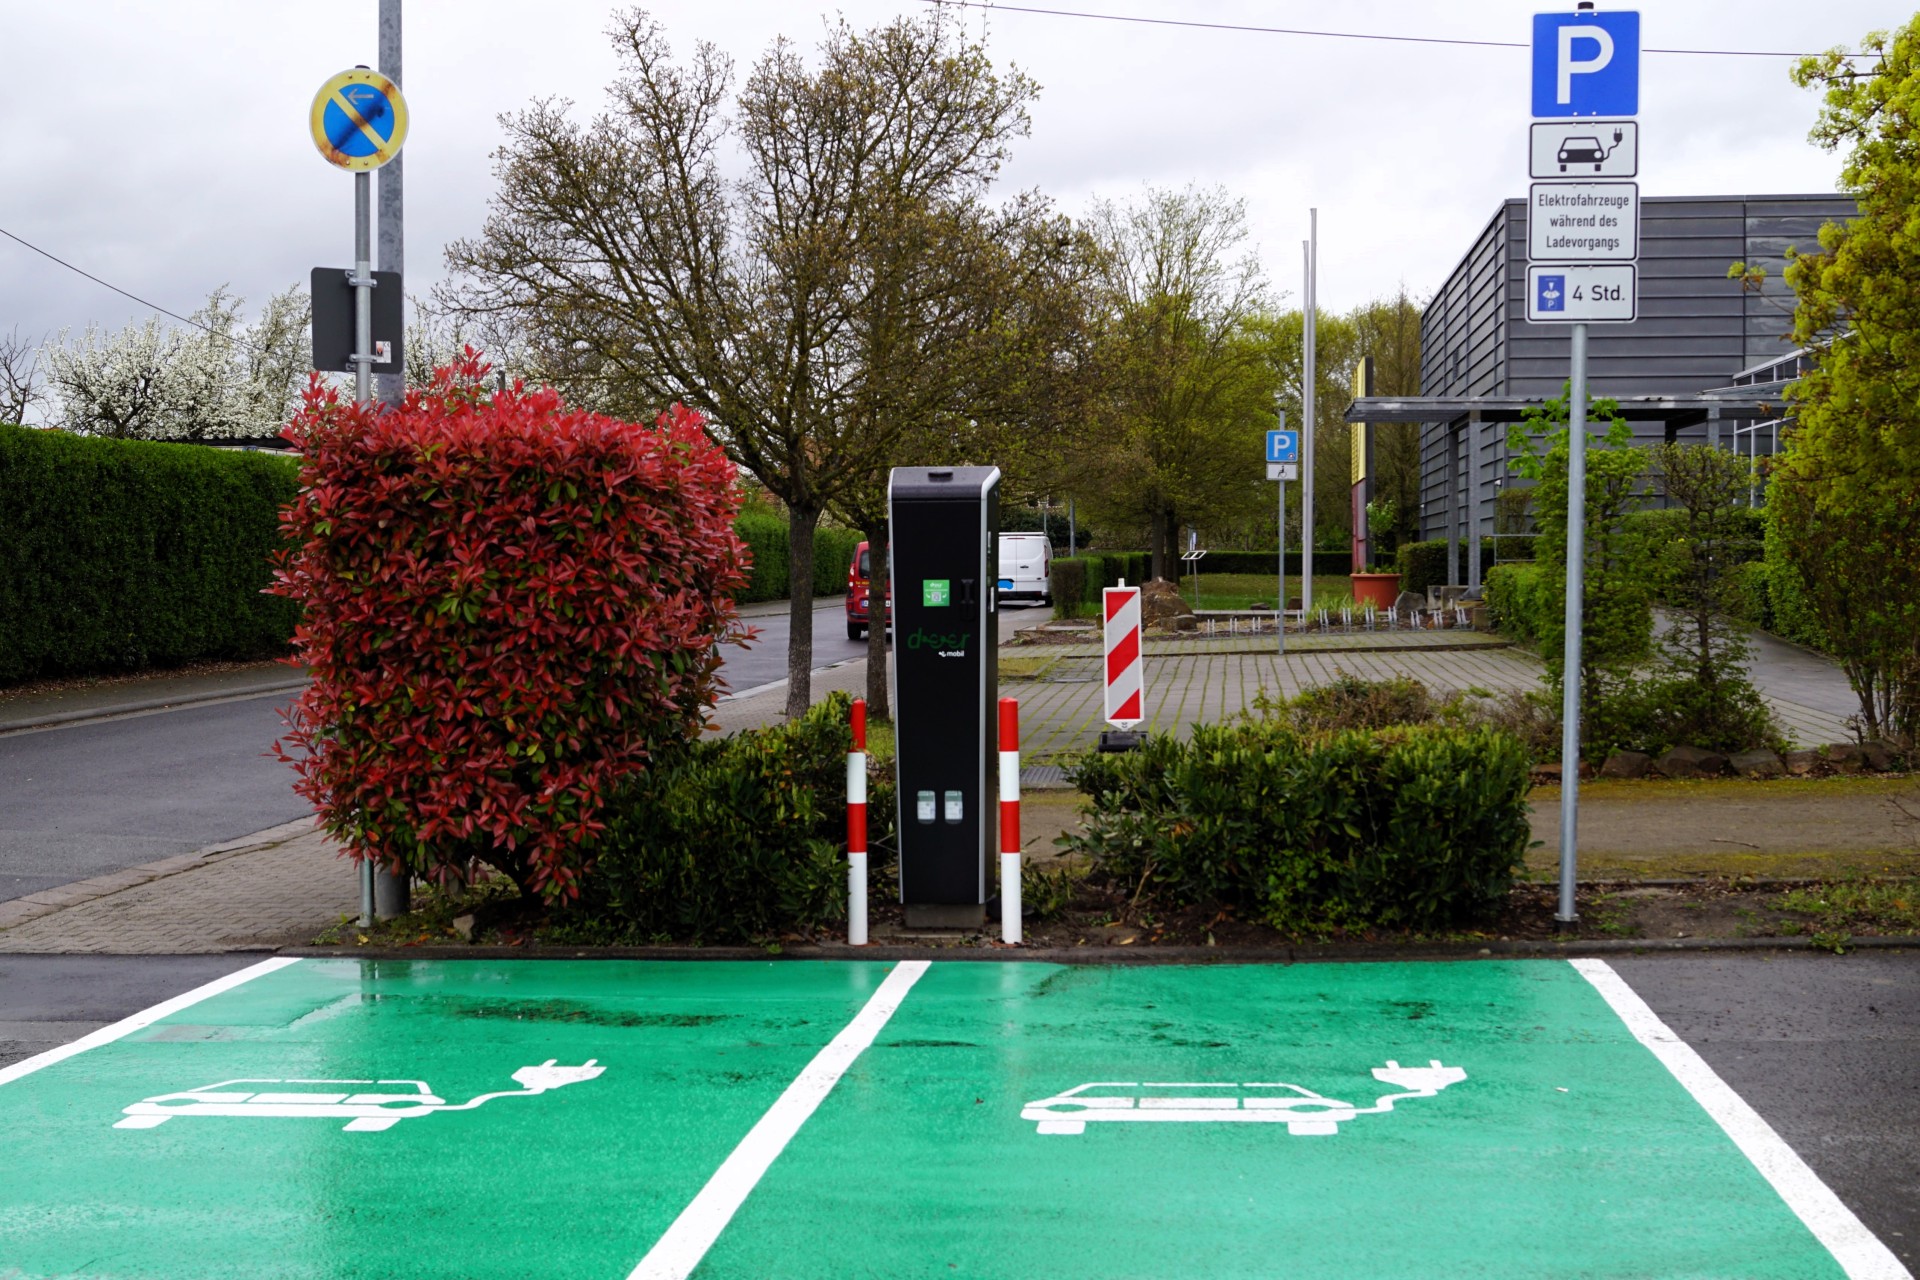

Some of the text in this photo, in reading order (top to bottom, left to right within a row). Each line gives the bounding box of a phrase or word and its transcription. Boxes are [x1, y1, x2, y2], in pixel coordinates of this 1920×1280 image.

[1557, 25, 1615, 105] P
[1538, 193, 1629, 209] Elektrofahrzeuge
[1550, 214, 1618, 227] während des
[1546, 235, 1620, 251] Ladevorgangs
[1572, 285, 1583, 301] 4
[1591, 285, 1625, 301] Std.
[1547, 300, 1555, 309] P
[1273, 434, 1291, 458] P
